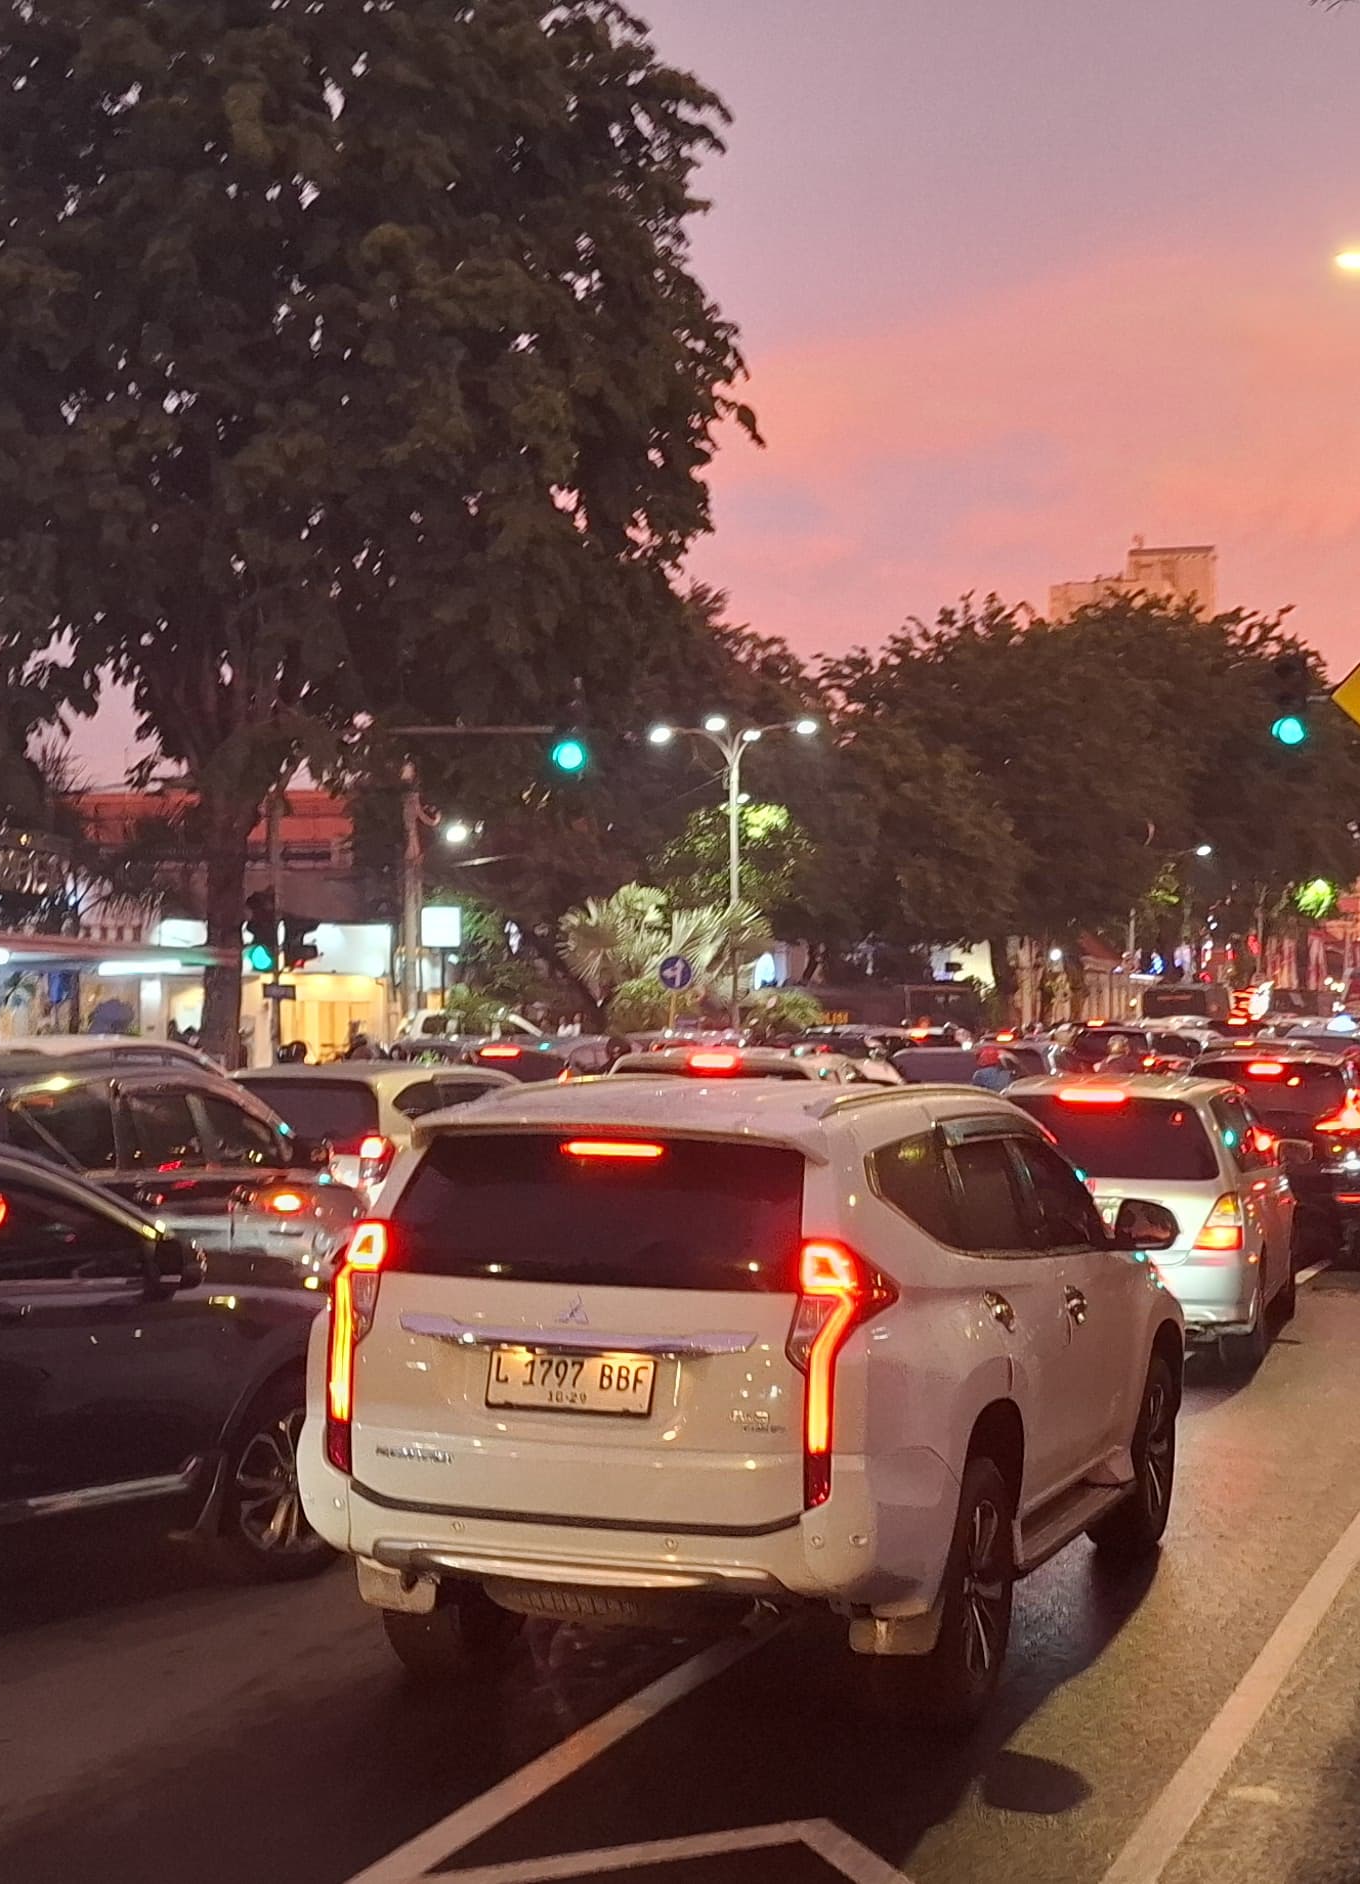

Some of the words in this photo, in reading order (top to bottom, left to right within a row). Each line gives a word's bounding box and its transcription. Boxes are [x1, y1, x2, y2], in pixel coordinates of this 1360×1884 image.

[495, 1357, 508, 1383] L
[522, 1359, 584, 1389] 1797
[598, 1363, 649, 1394] BBF
